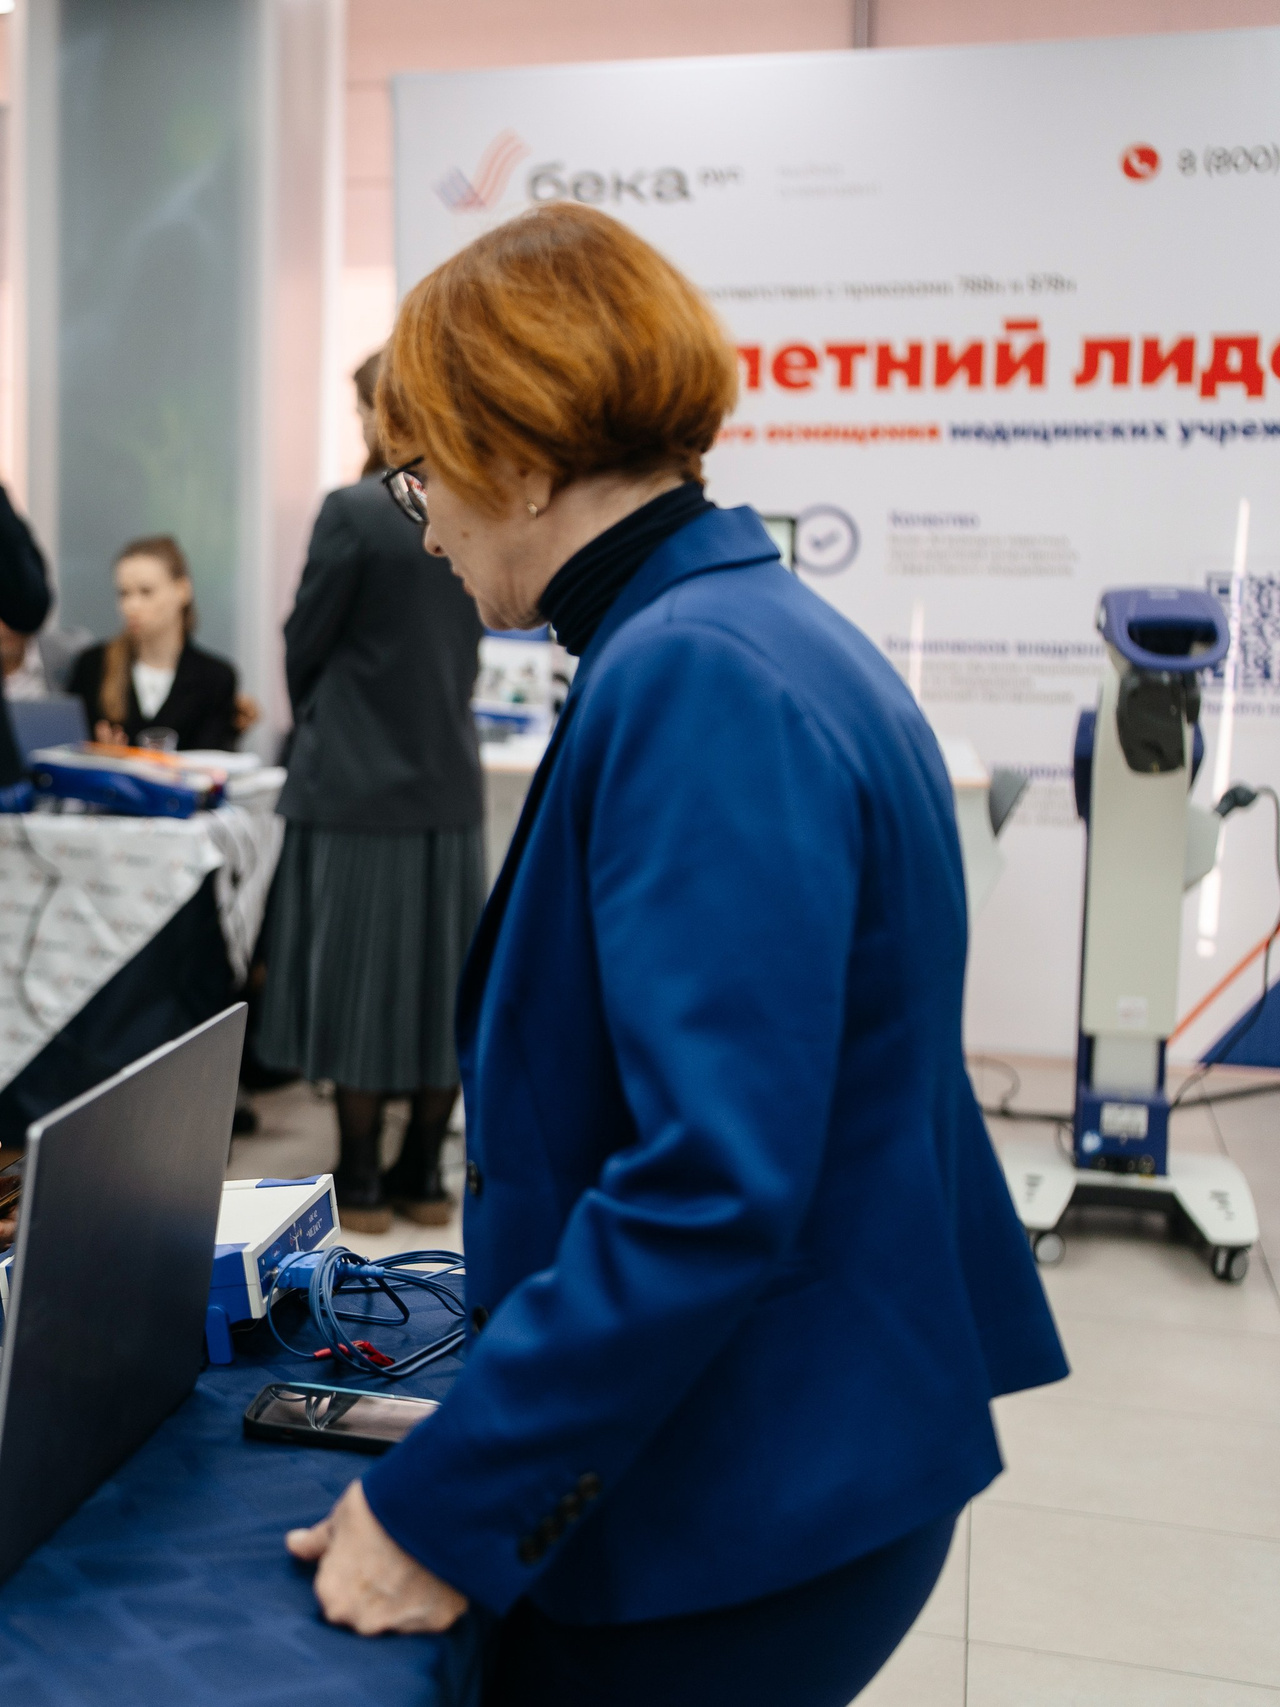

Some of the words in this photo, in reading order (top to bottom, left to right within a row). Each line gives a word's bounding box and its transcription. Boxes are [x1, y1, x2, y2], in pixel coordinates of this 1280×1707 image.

[528, 161, 693, 204] бека
[1177, 147, 1197, 177] 8
[1073, 334, 1280, 401] лид
